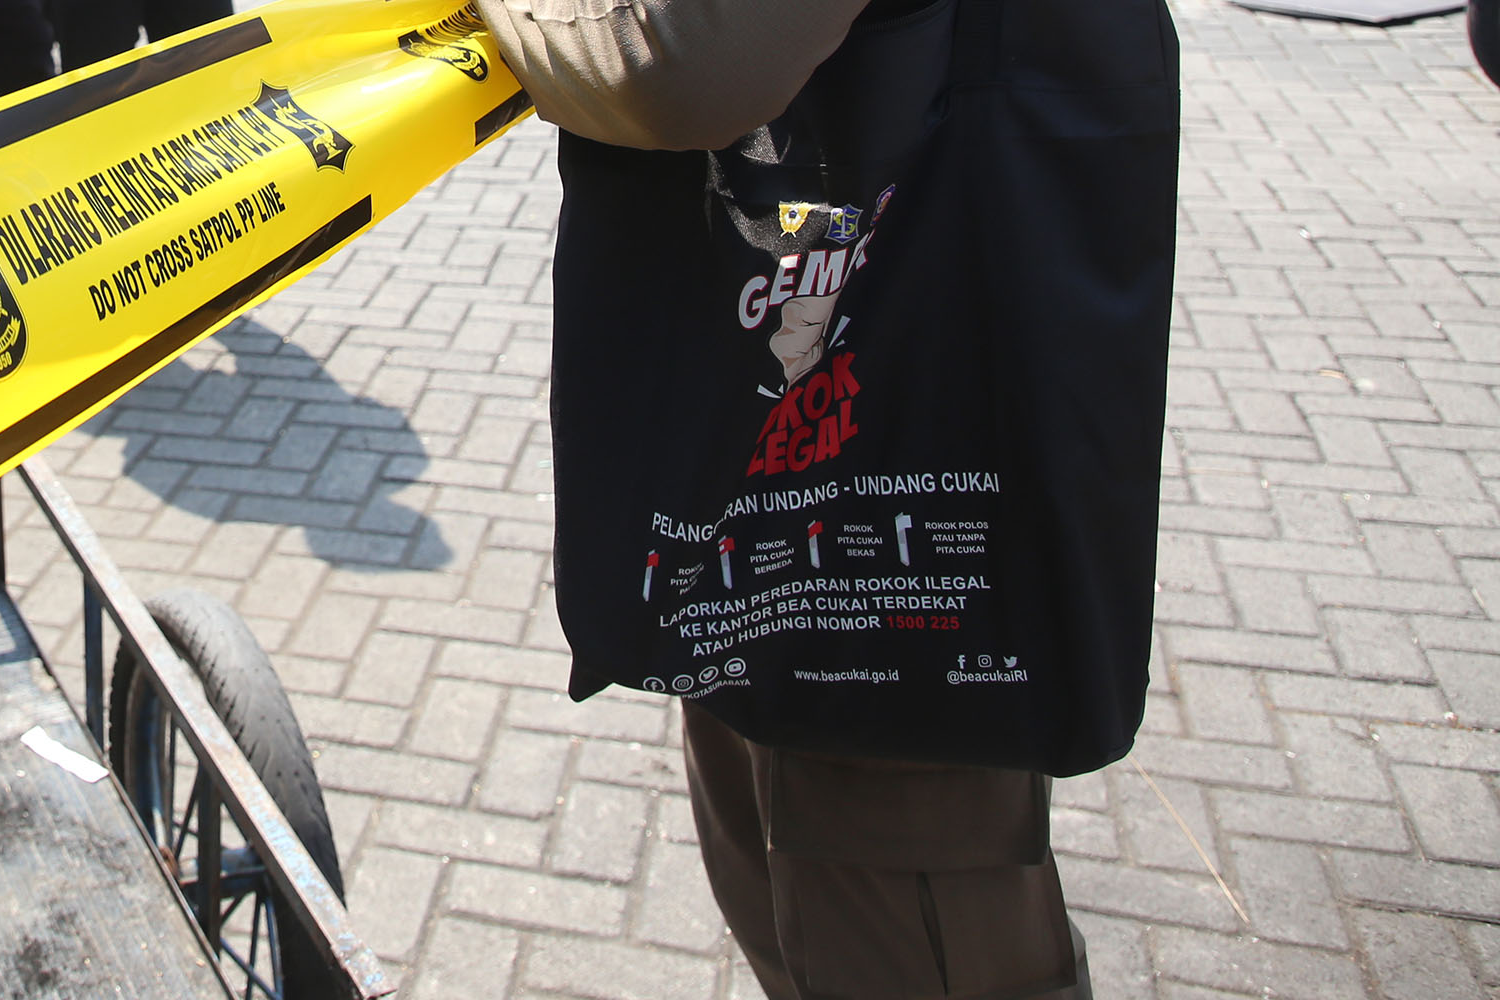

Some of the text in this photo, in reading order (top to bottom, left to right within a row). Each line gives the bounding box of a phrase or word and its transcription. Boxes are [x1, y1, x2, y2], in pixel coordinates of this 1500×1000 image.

[77, 152, 180, 237] MELINTAS
[152, 133, 223, 196] GARIS
[198, 112, 269, 180] SATPOL
[238, 106, 285, 150] PP
[88, 182, 286, 321] DO NOT CROSS SATPOL PP LINE
[763, 481, 838, 512] UNDANG
[854, 473, 936, 495] UNDANG
[941, 472, 1000, 493] CUKAI
[843, 524, 874, 533] ROKOK
[925, 521, 989, 530] ROKOK POLOS
[837, 537, 883, 545] PITA CUKAI
[932, 533, 986, 542] ATAU TANPA
[756, 540, 787, 551] ROKOK
[847, 549, 876, 557] BEKAS
[935, 545, 985, 554] PITA CUKAI
[750, 548, 795, 563] PITA CUKAI
[755, 558, 792, 575] BERBEDA
[671, 578, 688, 586] PITA
[659, 576, 991, 627] LAPORKAN PEREDARAN ROKOK ILEGAL
[680, 596, 967, 638] KE KANTOR BEA CUKAI TERDEKAT
[692, 615, 960, 657] ATAU HUBUNGI NOMOR 1500 225
[794, 668, 1028, 685] www.beacukai.go.id @beacukaiRI
